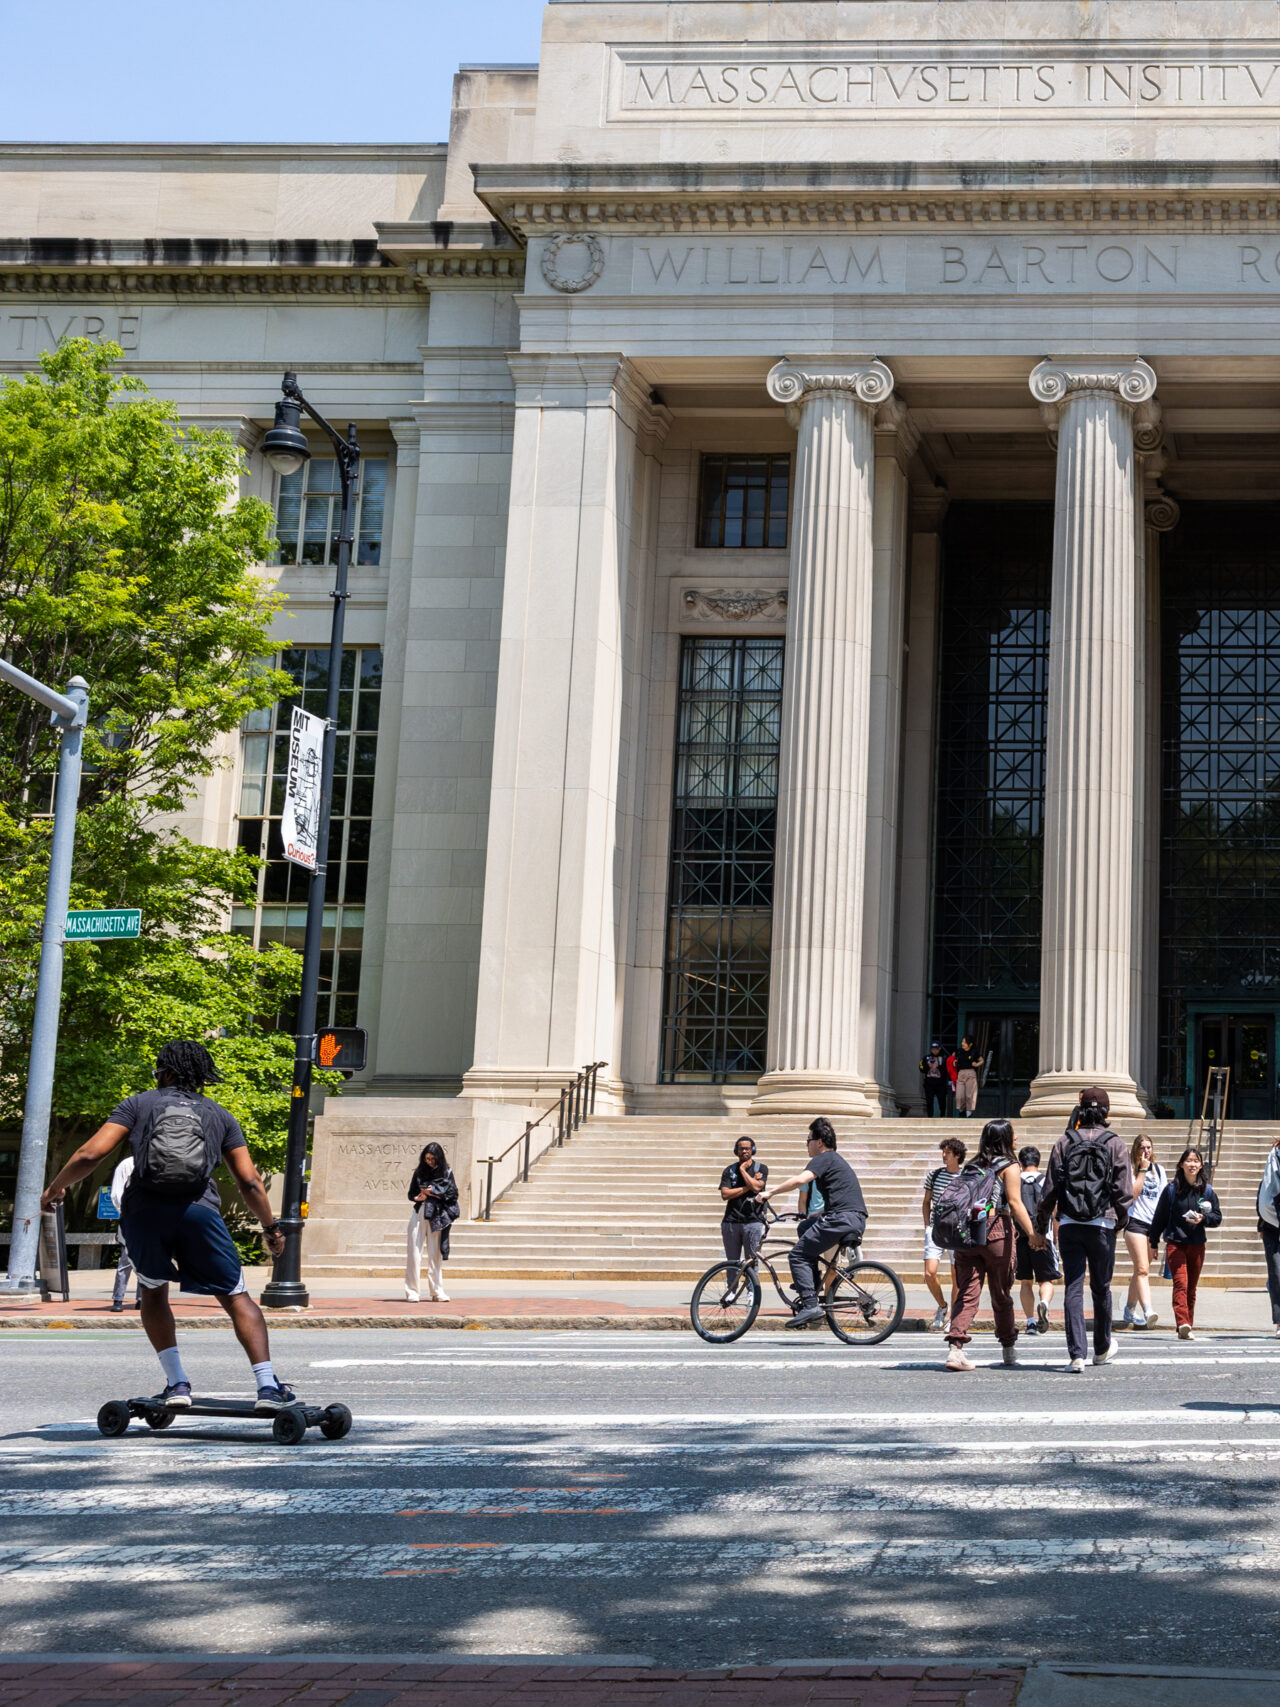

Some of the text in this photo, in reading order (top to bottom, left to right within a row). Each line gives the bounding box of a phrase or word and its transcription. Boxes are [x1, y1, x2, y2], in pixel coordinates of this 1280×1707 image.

[629, 65, 1056, 104] MASSACHVSETTS
[640, 246, 888, 285] WILLIAM
[939, 245, 1180, 284] BARTON
[0, 316, 139, 350] TVRE
[293, 710, 310, 732] MIT
[287, 842, 315, 866] Curious?
[66, 915, 139, 933] MASSACHUSETTS AVE
[362, 1180, 411, 1191] AVENV
